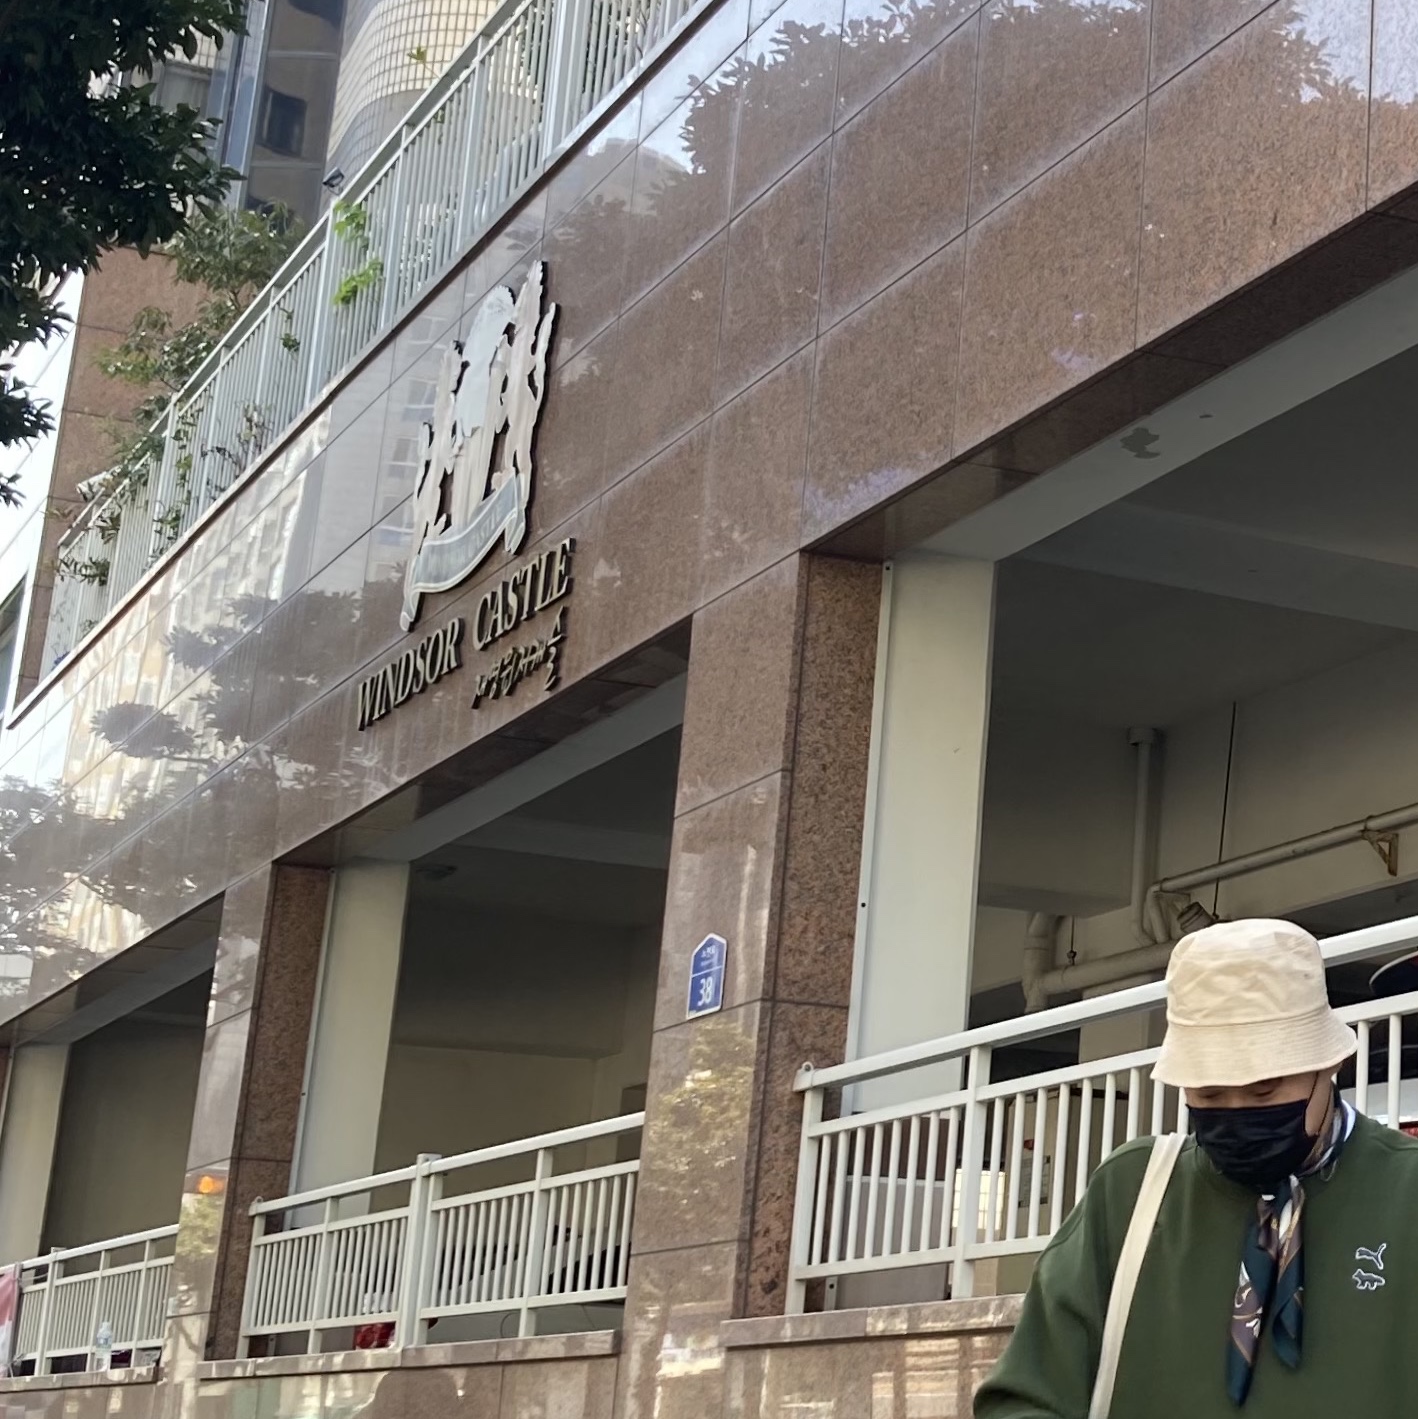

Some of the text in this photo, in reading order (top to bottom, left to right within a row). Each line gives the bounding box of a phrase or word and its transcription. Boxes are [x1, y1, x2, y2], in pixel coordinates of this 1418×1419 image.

[357, 537, 573, 730] WINDSOR CASTLE
[697, 976, 713, 1007] 38
